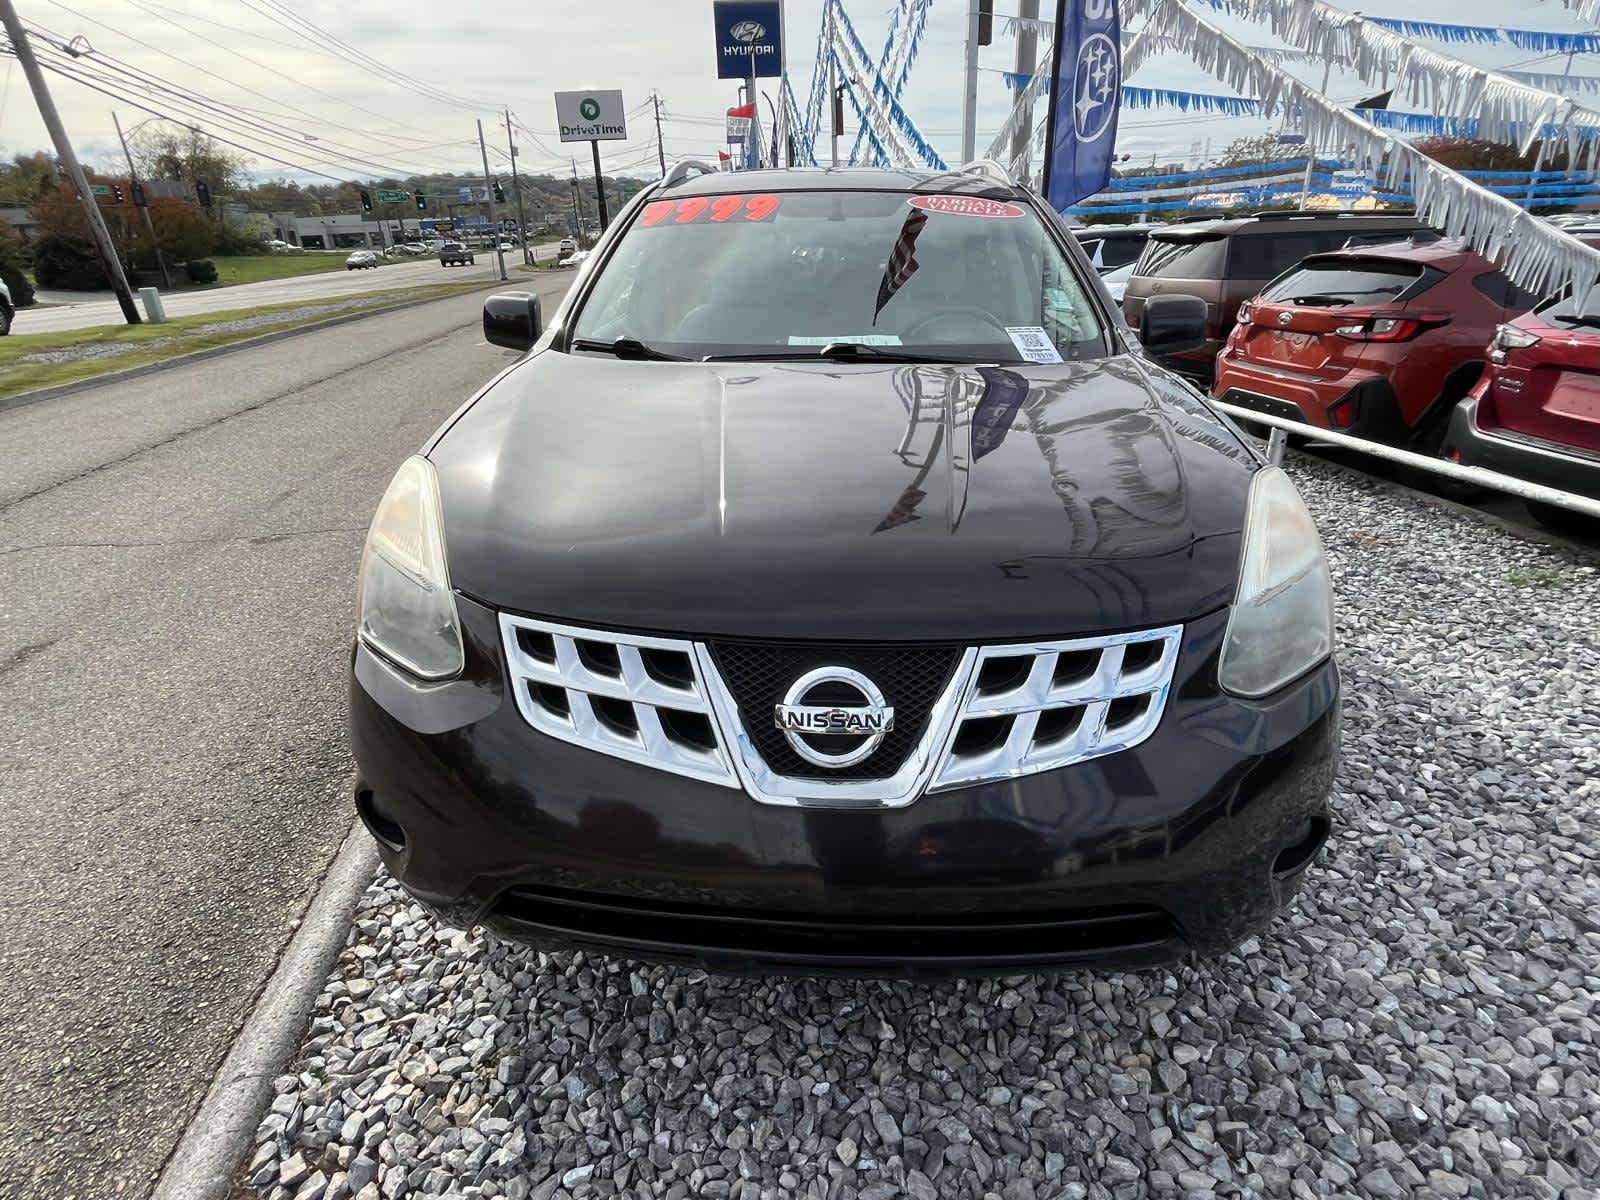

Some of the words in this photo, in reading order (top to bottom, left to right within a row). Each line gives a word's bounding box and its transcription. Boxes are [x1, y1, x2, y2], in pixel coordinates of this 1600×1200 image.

[724, 46, 775, 56] HYUNDAI
[561, 124, 624, 135] DriveTime
[926, 197, 1005, 209] BARGAIN
[641, 195, 780, 228] 9999
[930, 203, 1007, 216] VEHICLE
[788, 711, 882, 728] NISSAN
